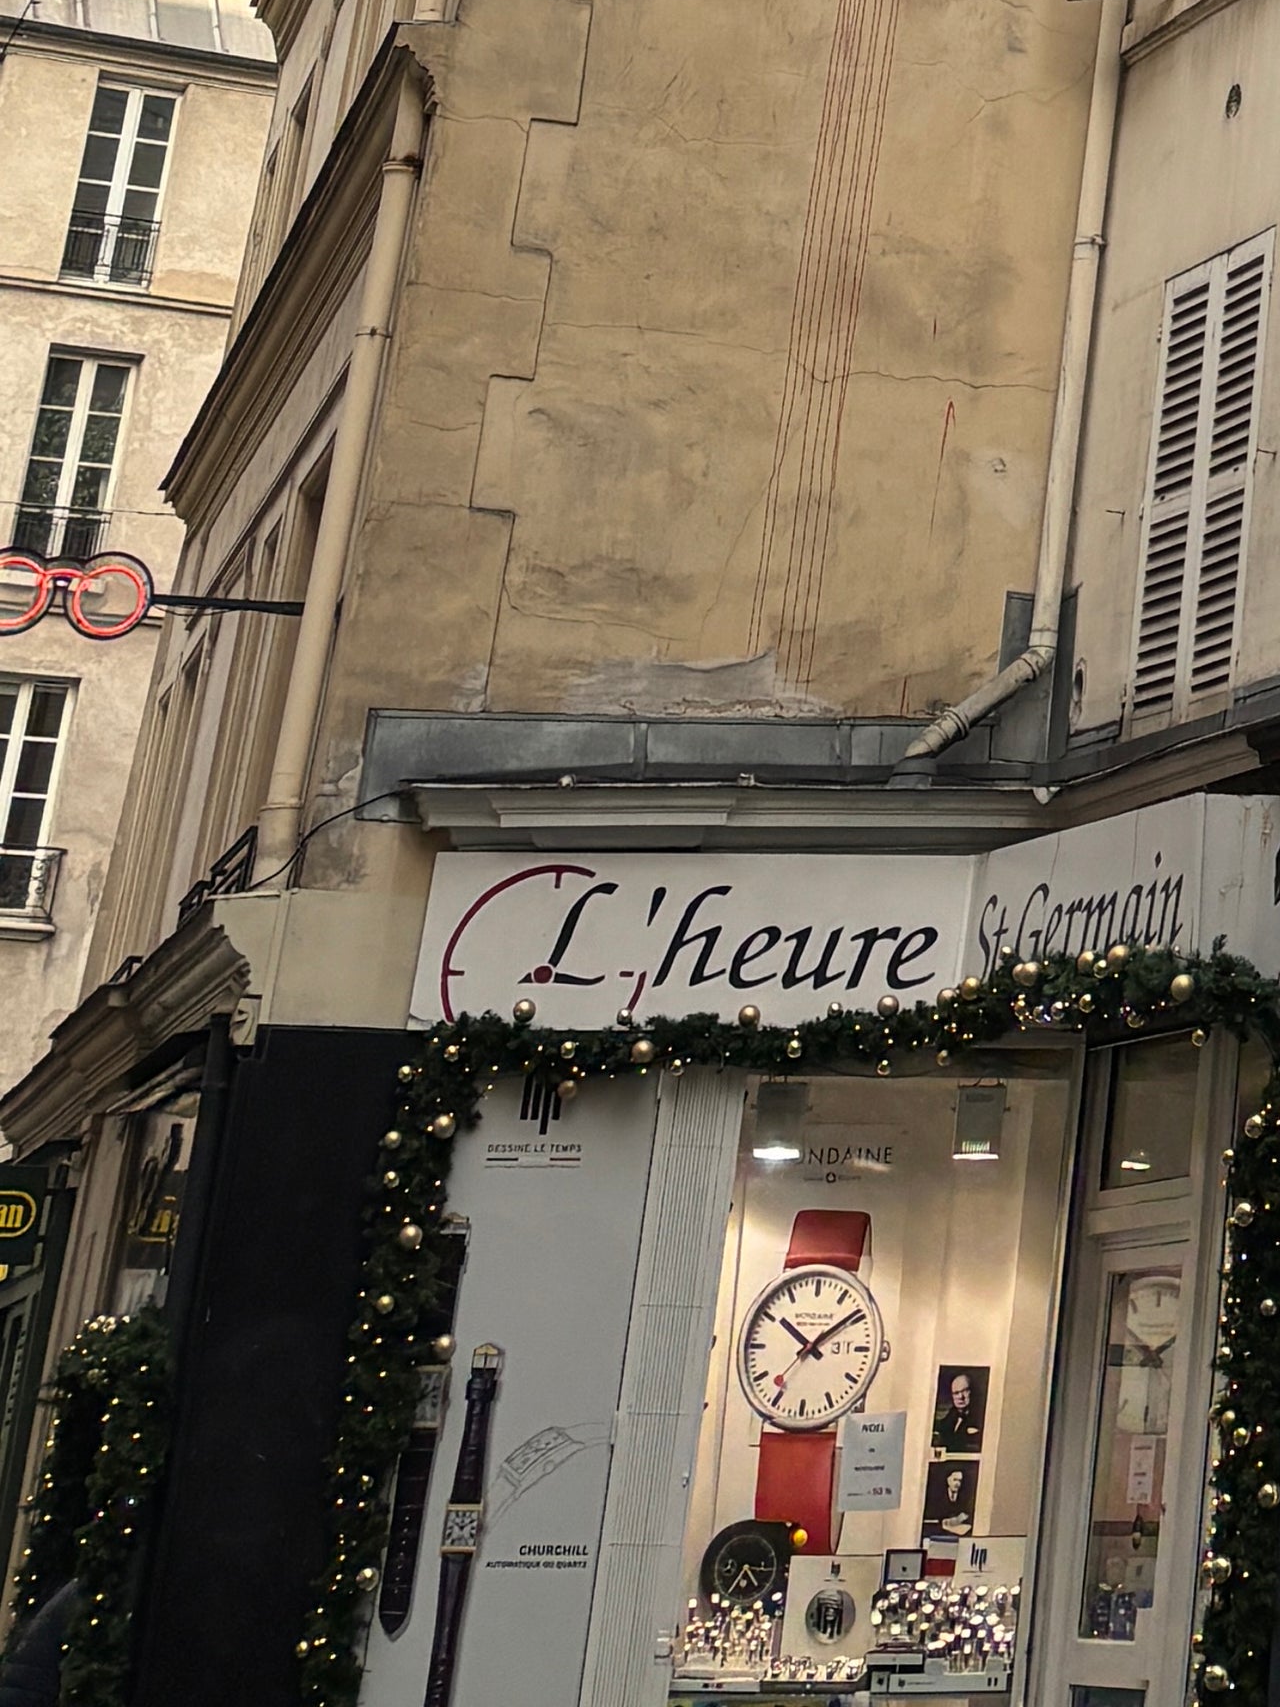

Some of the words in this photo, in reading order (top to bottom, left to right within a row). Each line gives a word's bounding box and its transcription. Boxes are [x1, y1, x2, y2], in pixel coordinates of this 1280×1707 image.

[518, 882, 939, 990] L'heure
[978, 894, 1009, 985] St
[1014, 850, 1184, 963] Germain
[549, 1143, 582, 1154] TEMPS
[519, 1544, 589, 1557] CHURCHILL
